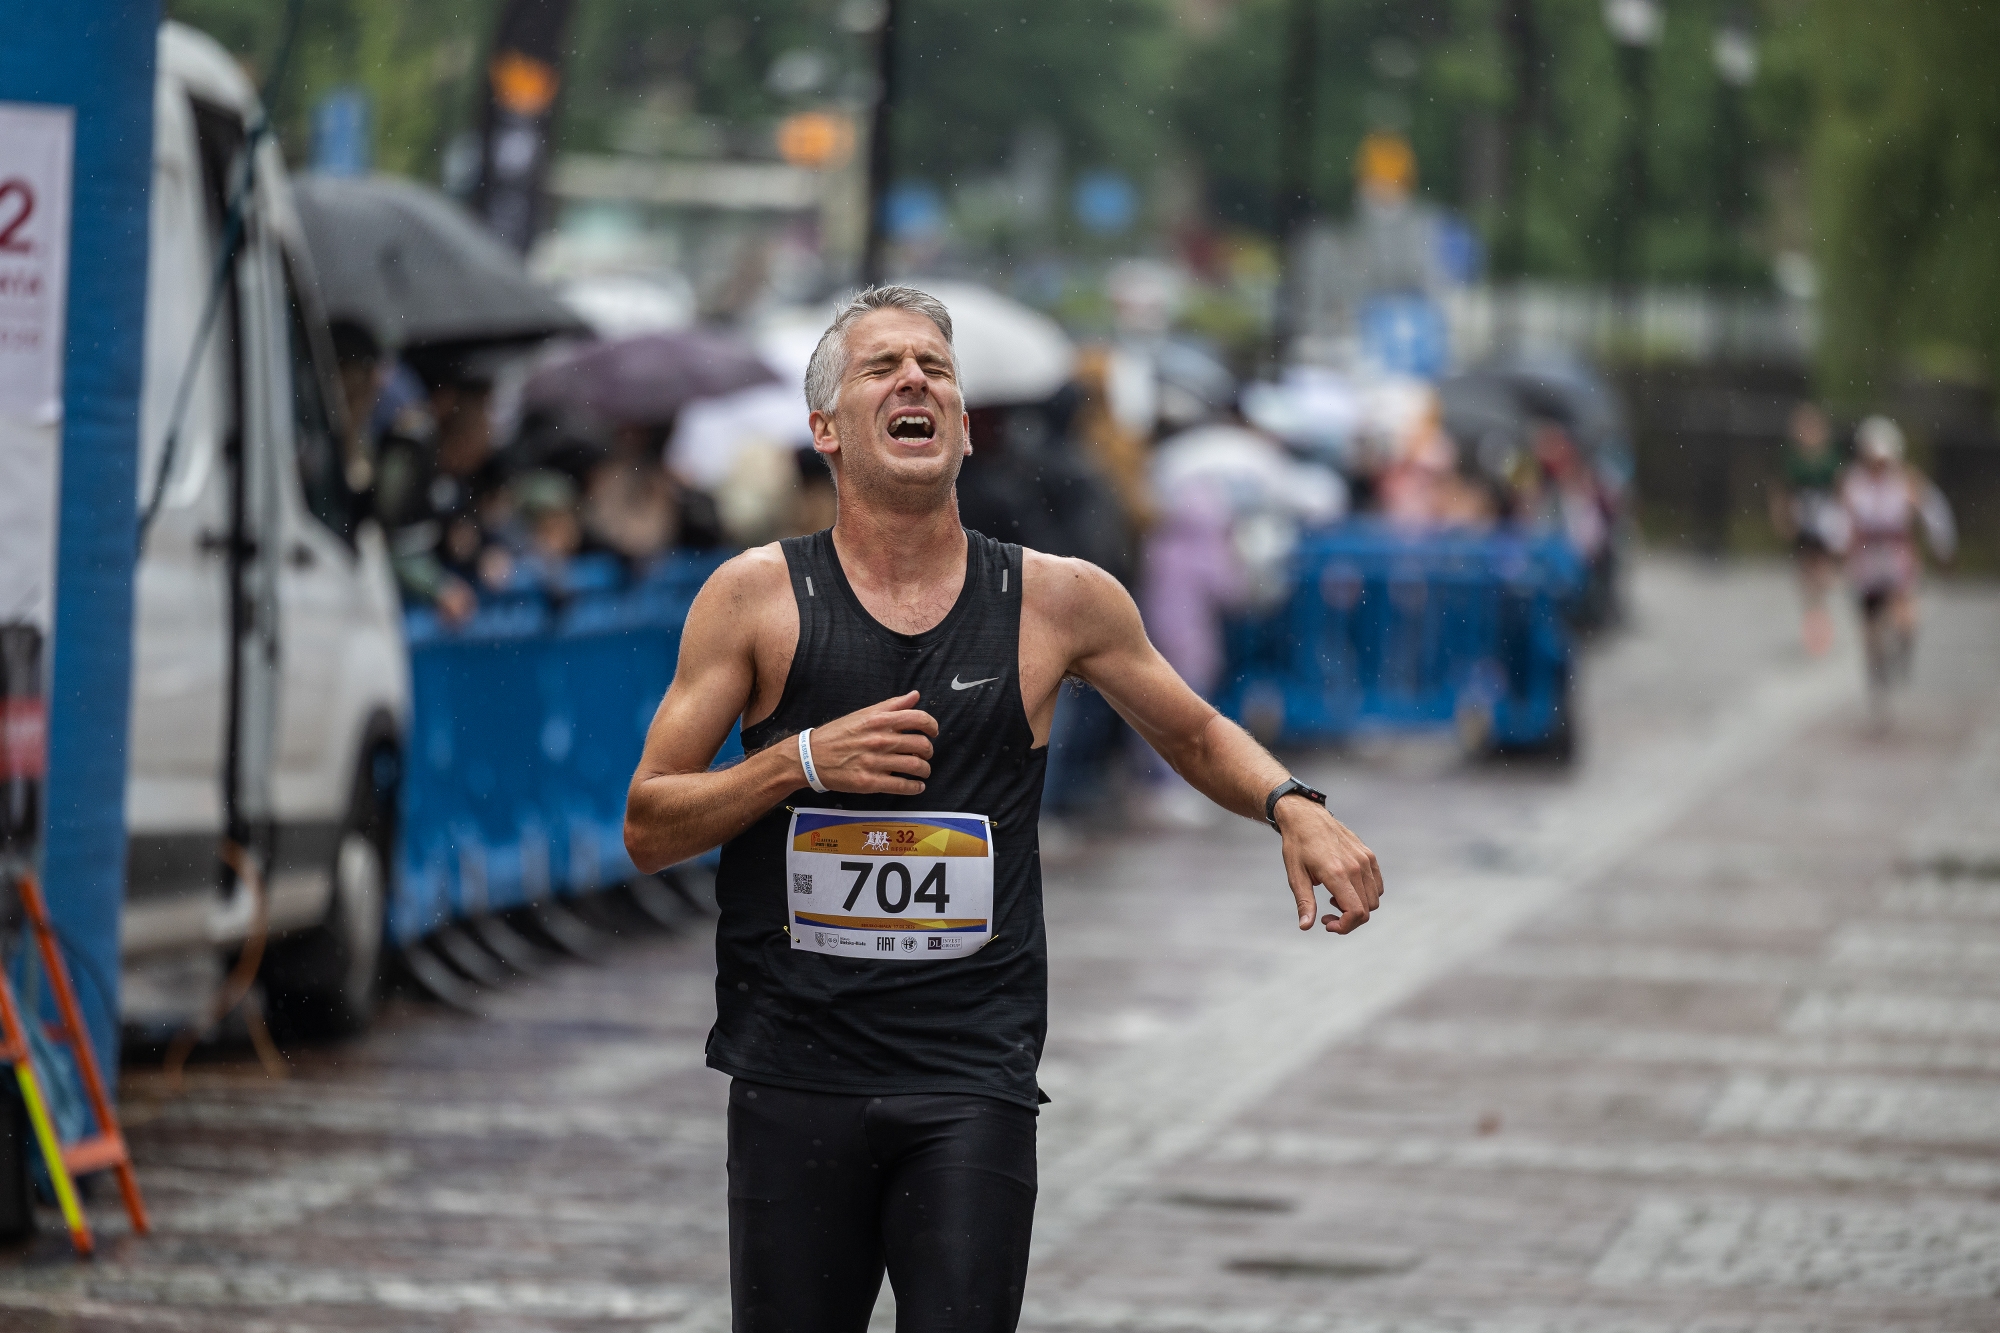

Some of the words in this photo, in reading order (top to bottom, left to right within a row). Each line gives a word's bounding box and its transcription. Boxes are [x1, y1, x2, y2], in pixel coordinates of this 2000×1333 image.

[840, 862, 950, 914] 704
[877, 937, 895, 951] FIAT
[929, 939, 941, 948] DL
